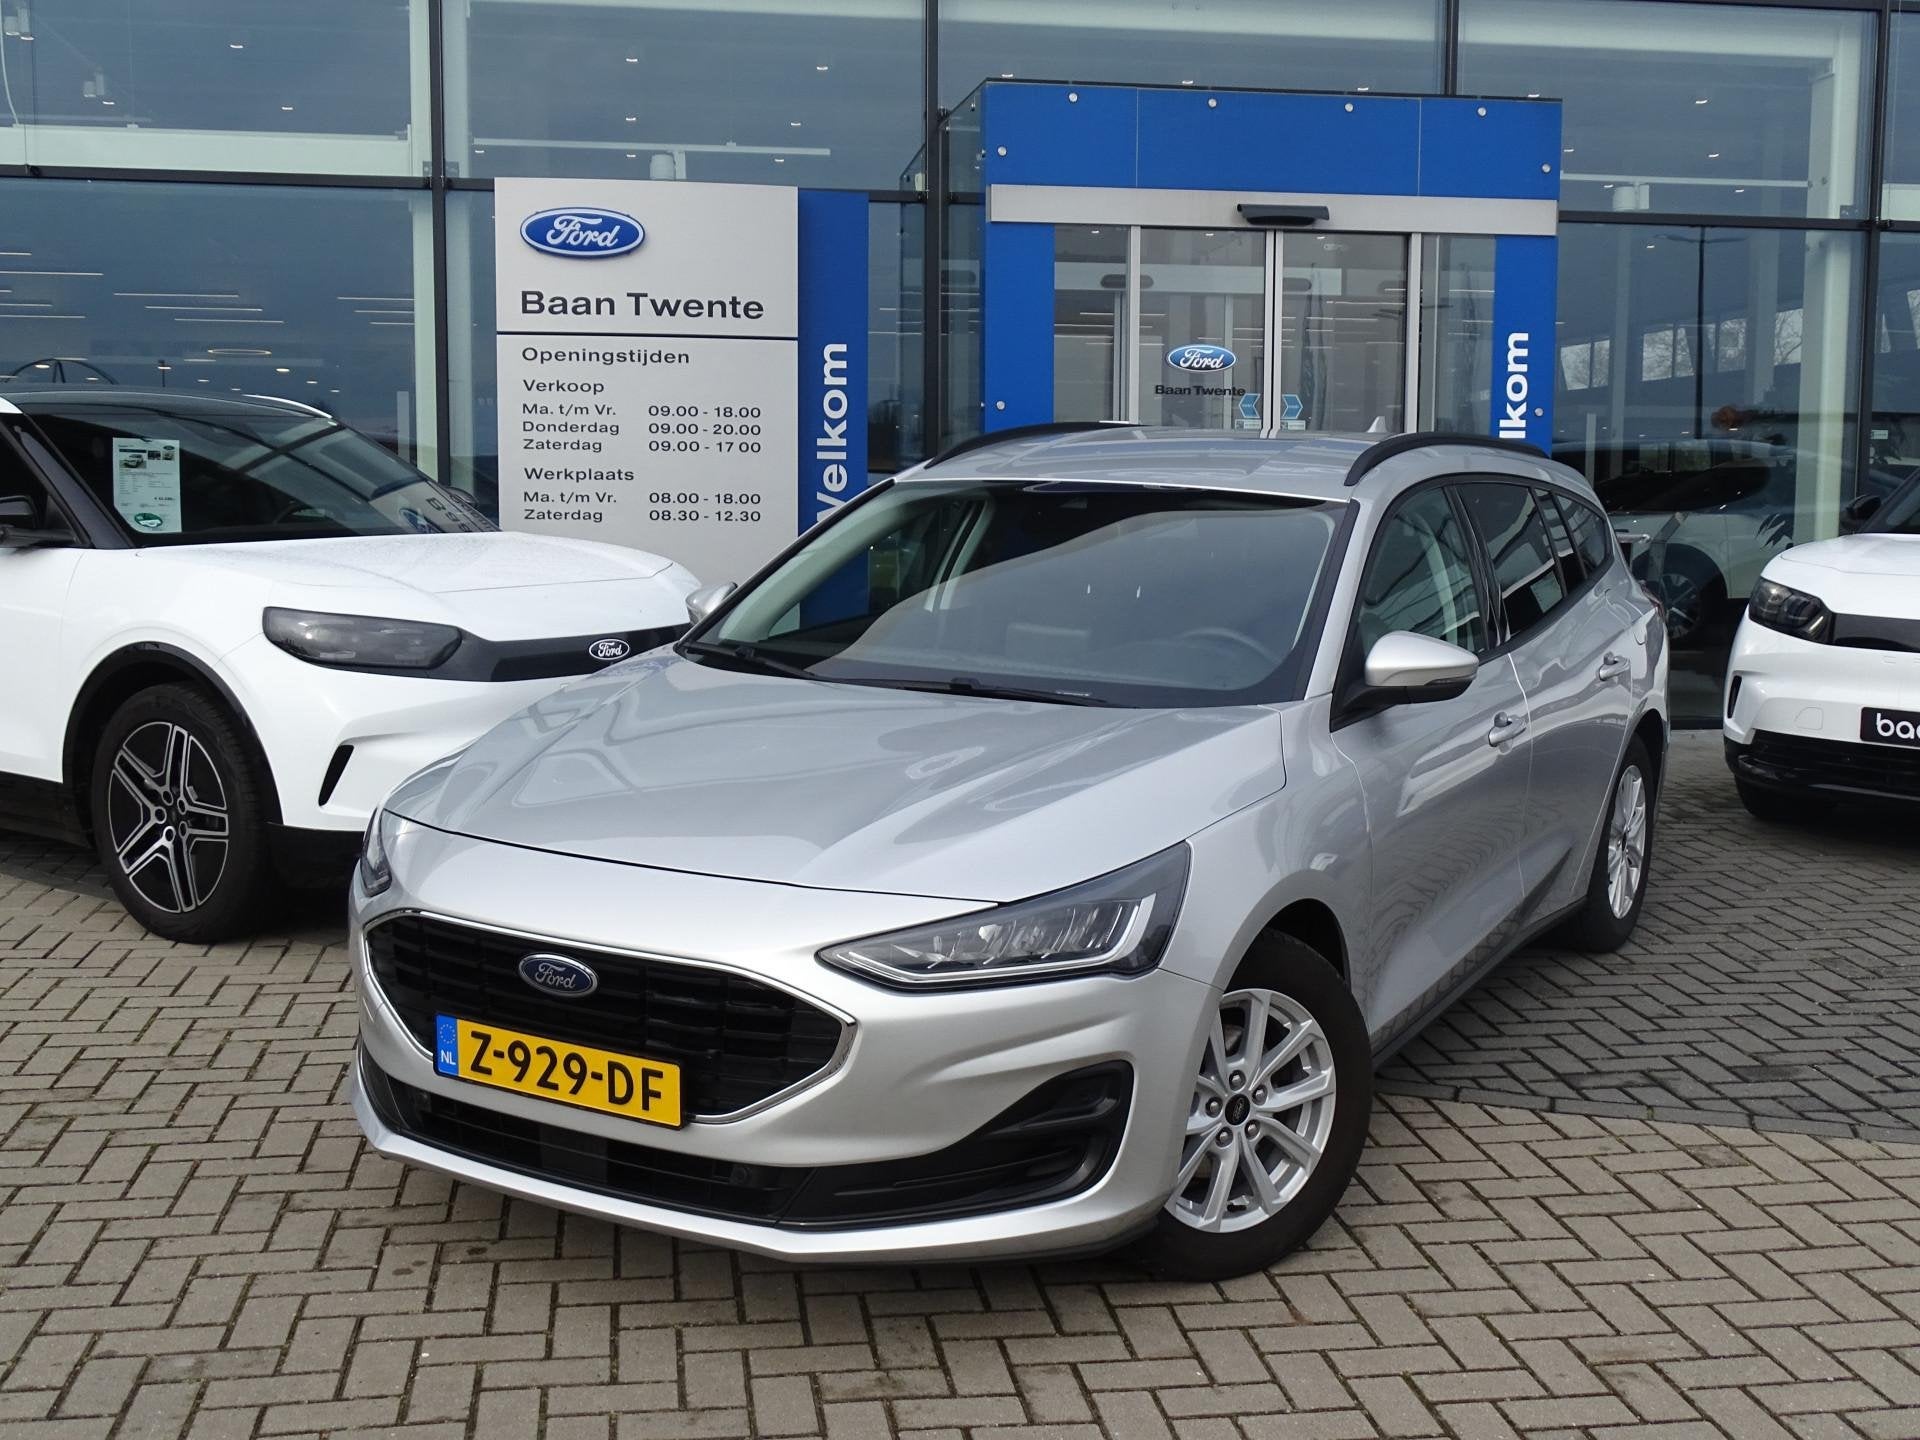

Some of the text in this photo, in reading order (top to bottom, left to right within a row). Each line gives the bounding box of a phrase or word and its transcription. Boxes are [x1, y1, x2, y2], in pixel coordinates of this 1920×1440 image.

[545, 214, 621, 248] Ford
[521, 290, 764, 320] Baan Twente
[521, 346, 690, 367] Openingstijden
[1179, 348, 1225, 369] Ford
[522, 379, 605, 396] Verkoop
[1154, 384, 1246, 397] Baan Twente
[522, 403, 554, 416] Ma.
[558, 403, 590, 417] t/m
[593, 404, 617, 416] Vr.
[648, 405, 699, 418] 09.00
[714, 406, 762, 419] 18.00
[522, 421, 620, 436] Donderdag
[648, 422, 699, 435] 09.00
[712, 423, 762, 436] 20.00
[522, 438, 603, 453] Zaterdag
[648, 440, 701, 453] 09.00
[524, 467, 635, 484] Werkplaats
[523, 491, 555, 504] Ma.
[559, 491, 591, 505] t/m
[594, 492, 618, 504] Vr.
[649, 492, 700, 505] 08.00
[714, 493, 762, 505] 18.00
[523, 508, 604, 524] Zaterdag
[649, 510, 700, 523] 08.30
[714, 511, 762, 523] 12.30
[597, 641, 623, 658] Ford
[1875, 712, 1920, 740] ba
[535, 961, 577, 989] Ford
[440, 1050, 457, 1066] NL
[469, 1029, 665, 1112] Z-929-DF
